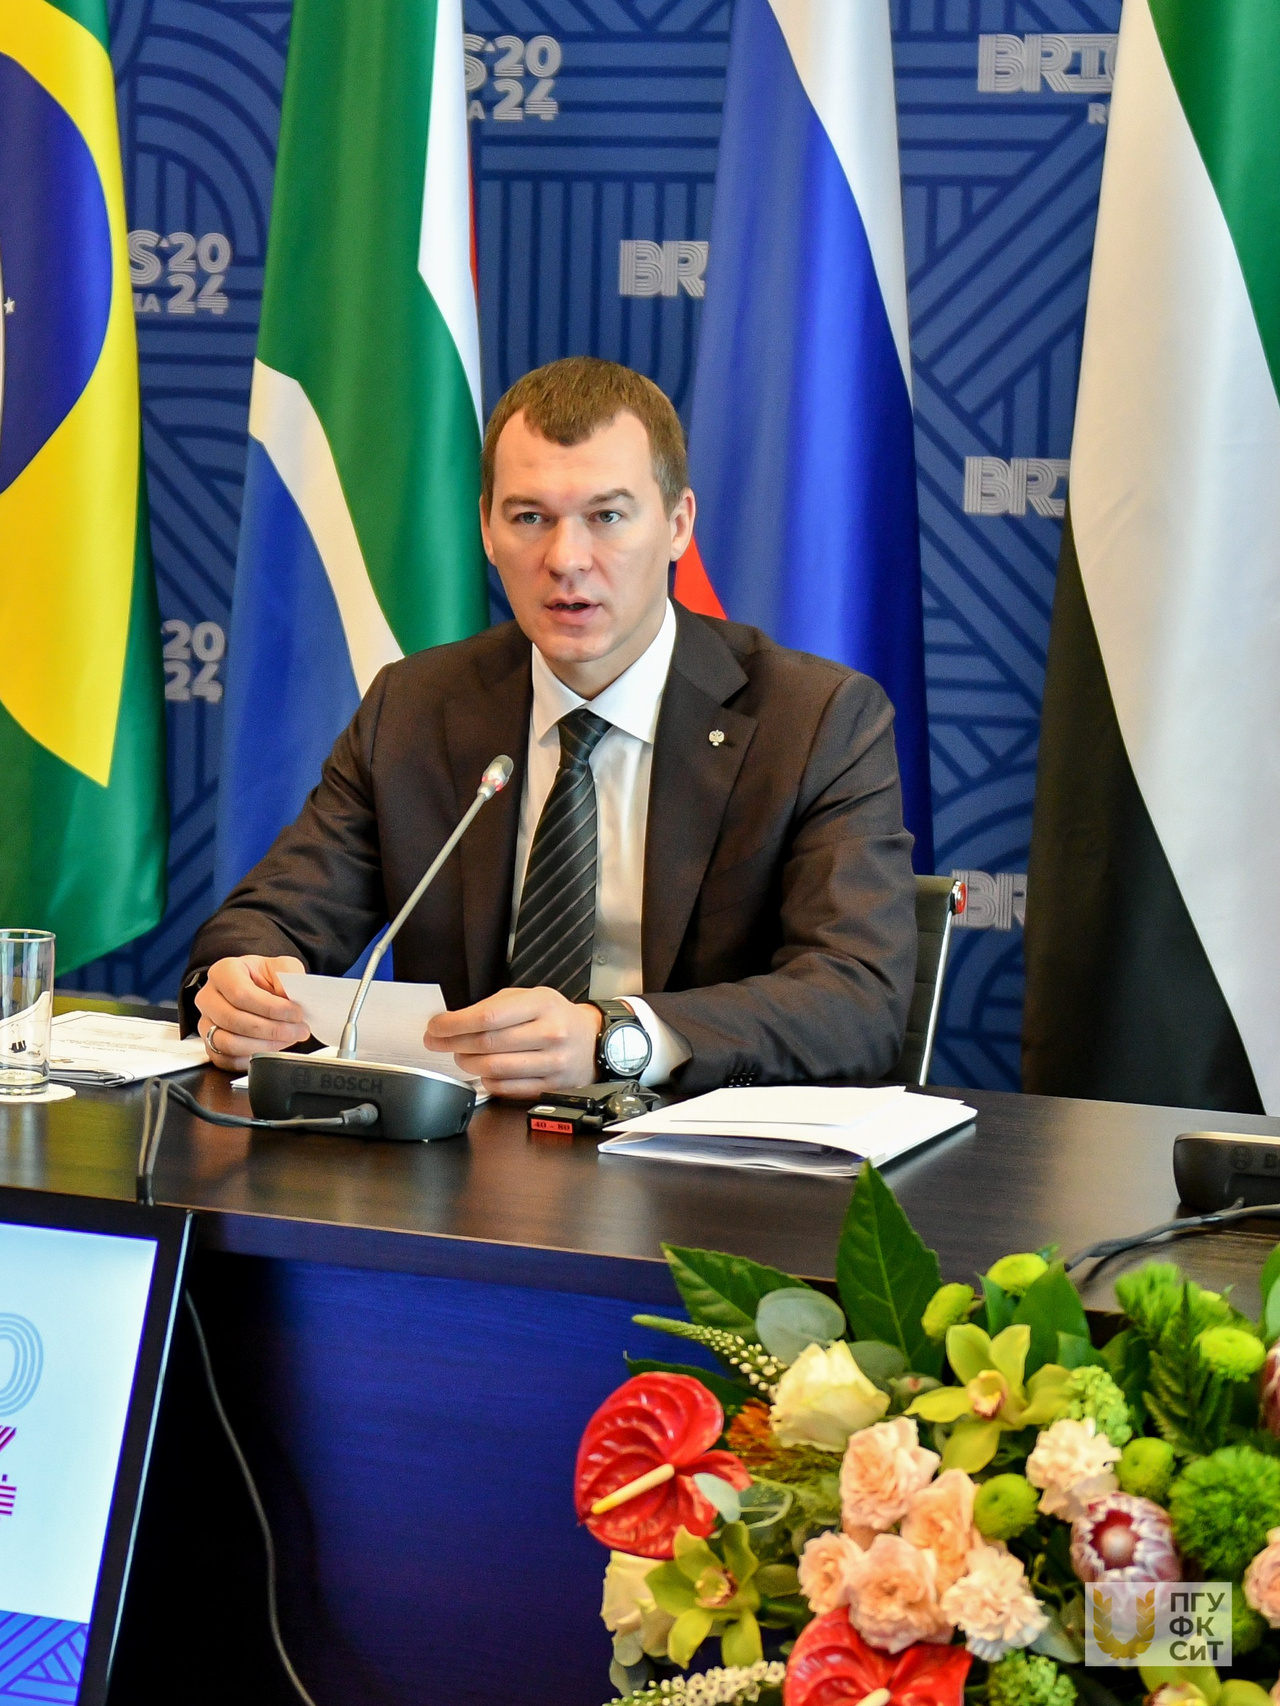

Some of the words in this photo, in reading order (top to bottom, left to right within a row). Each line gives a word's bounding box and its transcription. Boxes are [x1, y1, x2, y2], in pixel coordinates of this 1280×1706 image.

[963, 456, 1070, 518] BR
[161, 619, 225, 662] 20
[164, 660, 224, 703] 24
[320, 1074, 384, 1093] BOSCH
